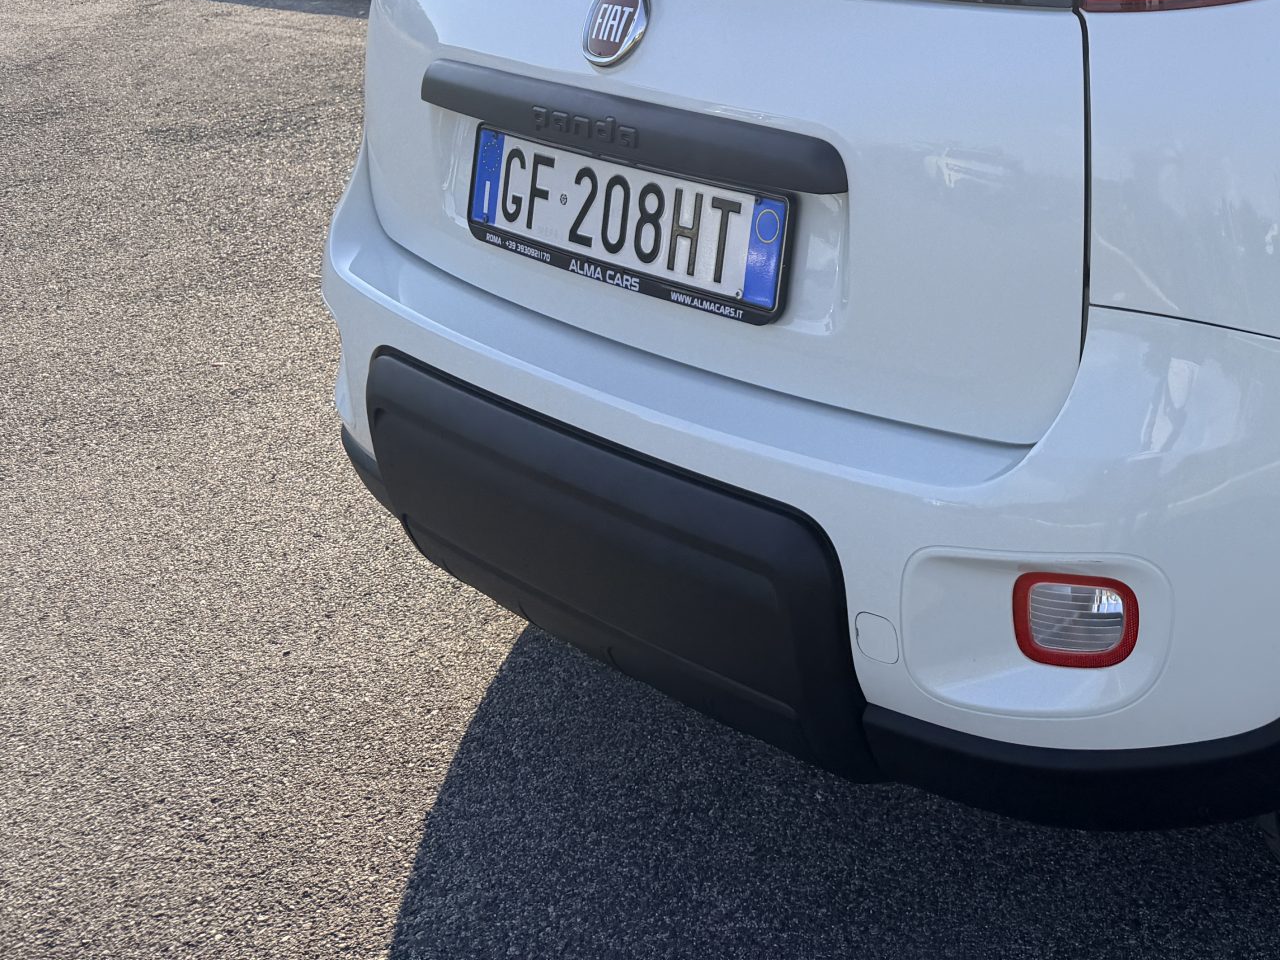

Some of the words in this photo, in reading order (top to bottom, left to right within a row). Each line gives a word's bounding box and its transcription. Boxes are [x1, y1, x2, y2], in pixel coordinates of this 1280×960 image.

[592, 3, 634, 43] FIAT
[532, 106, 637, 147] panda
[501, 147, 555, 230] GF
[568, 166, 742, 284] 208HT
[486, 233, 501, 245] ROMA
[568, 259, 603, 281] ALMA
[605, 270, 640, 292] CARS
[670, 291, 743, 319] WWW.ALMACARS.IT
